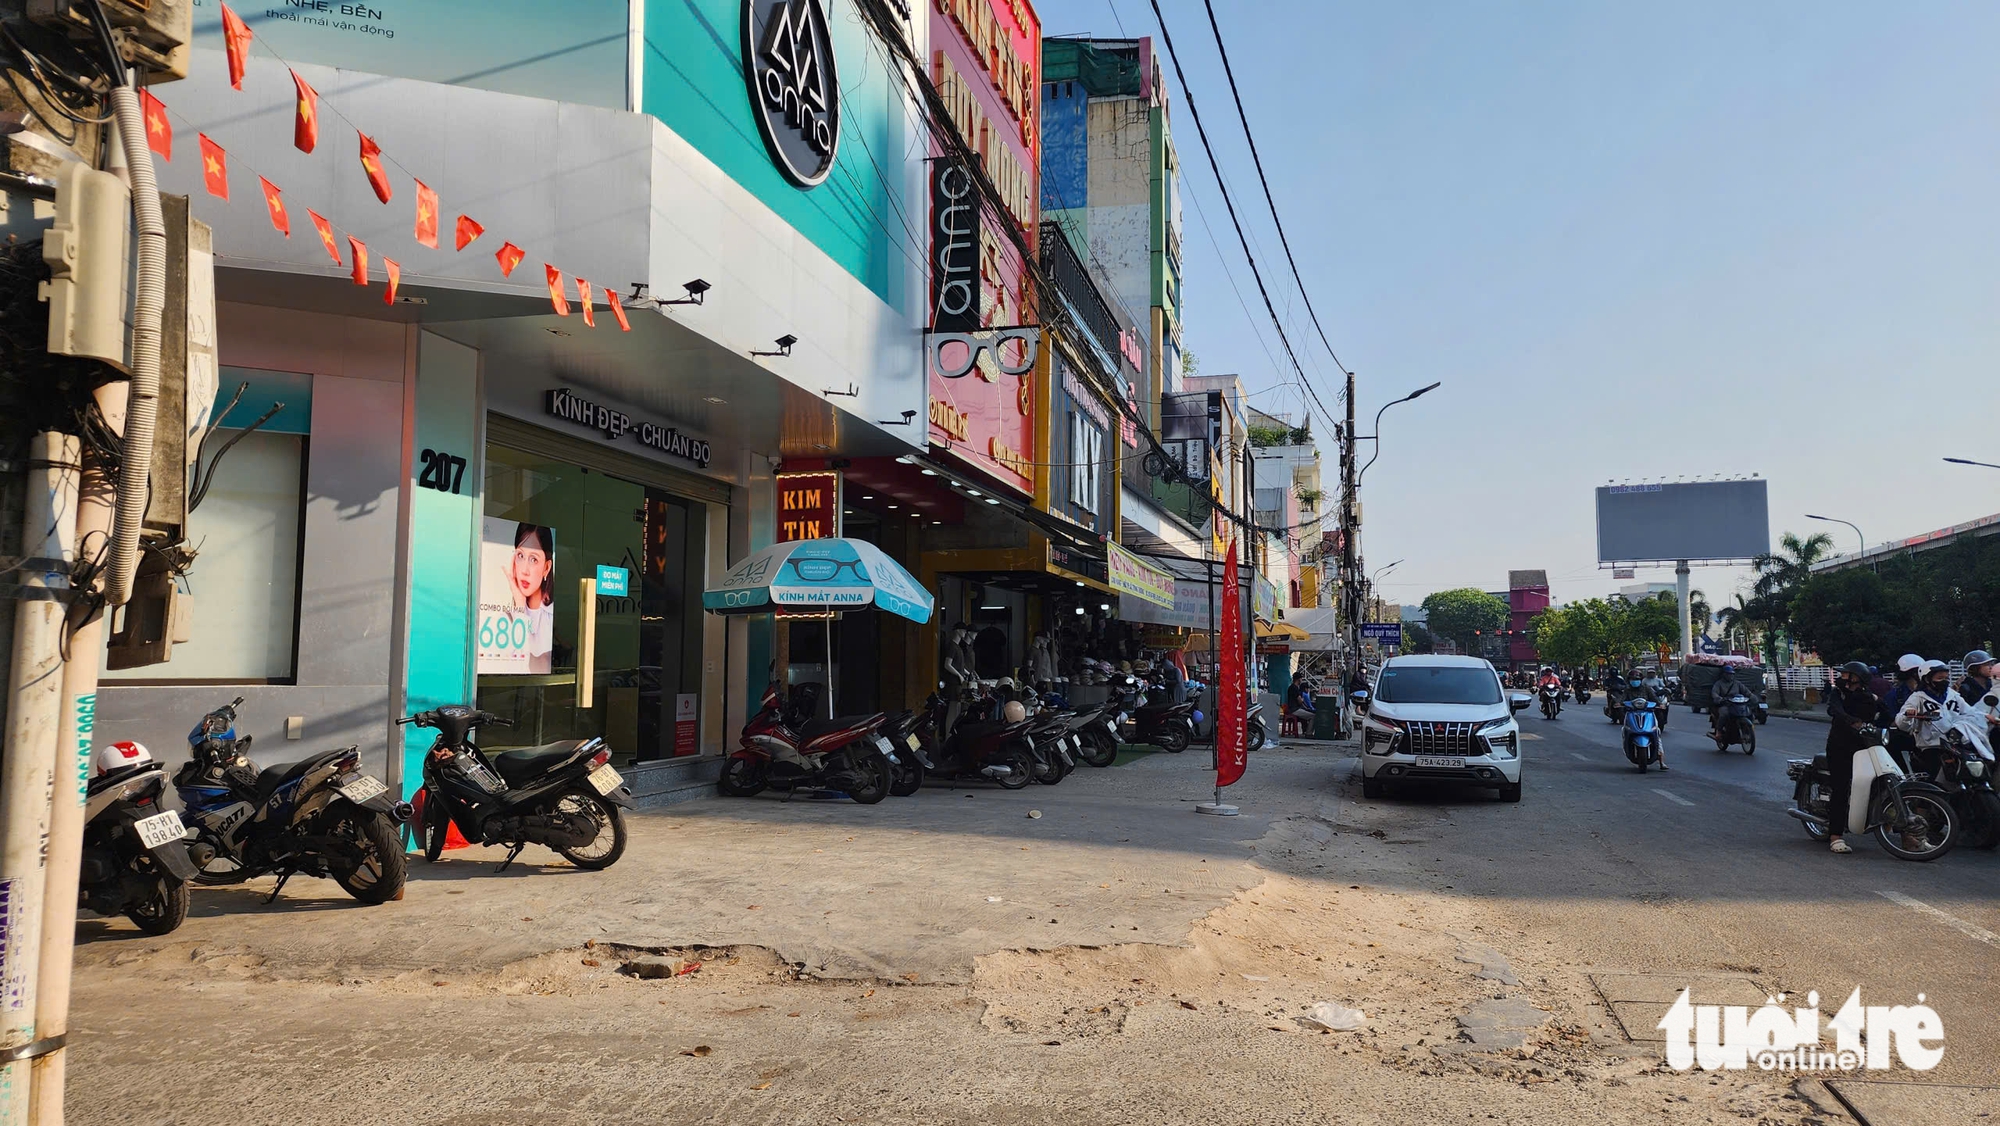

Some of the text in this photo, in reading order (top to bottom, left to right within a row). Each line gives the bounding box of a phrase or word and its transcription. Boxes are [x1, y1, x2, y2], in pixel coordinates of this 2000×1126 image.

[265, 9, 395, 39] thoải mái vận động
[340, 4, 383, 21] BỀN
[766, 68, 831, 155] anna
[939, 164, 972, 316] anna
[552, 389, 594, 426] KÍNH
[597, 405, 631, 439] ĐẸP
[641, 422, 689, 457] CHUẨN
[692, 439, 712, 468] ĐỘ
[419, 448, 467, 495] 207
[783, 488, 821, 511] KIM
[783, 516, 820, 540] TÍN
[723, 575, 764, 587] anna
[778, 591, 805, 602] KÍNH
[833, 593, 864, 602] ANNA
[479, 616, 526, 650] 680
[1233, 716, 1244, 766] KÍNH
[1419, 758, 1462, 767] 75A-423.29
[144, 823, 184, 847] 198.40
